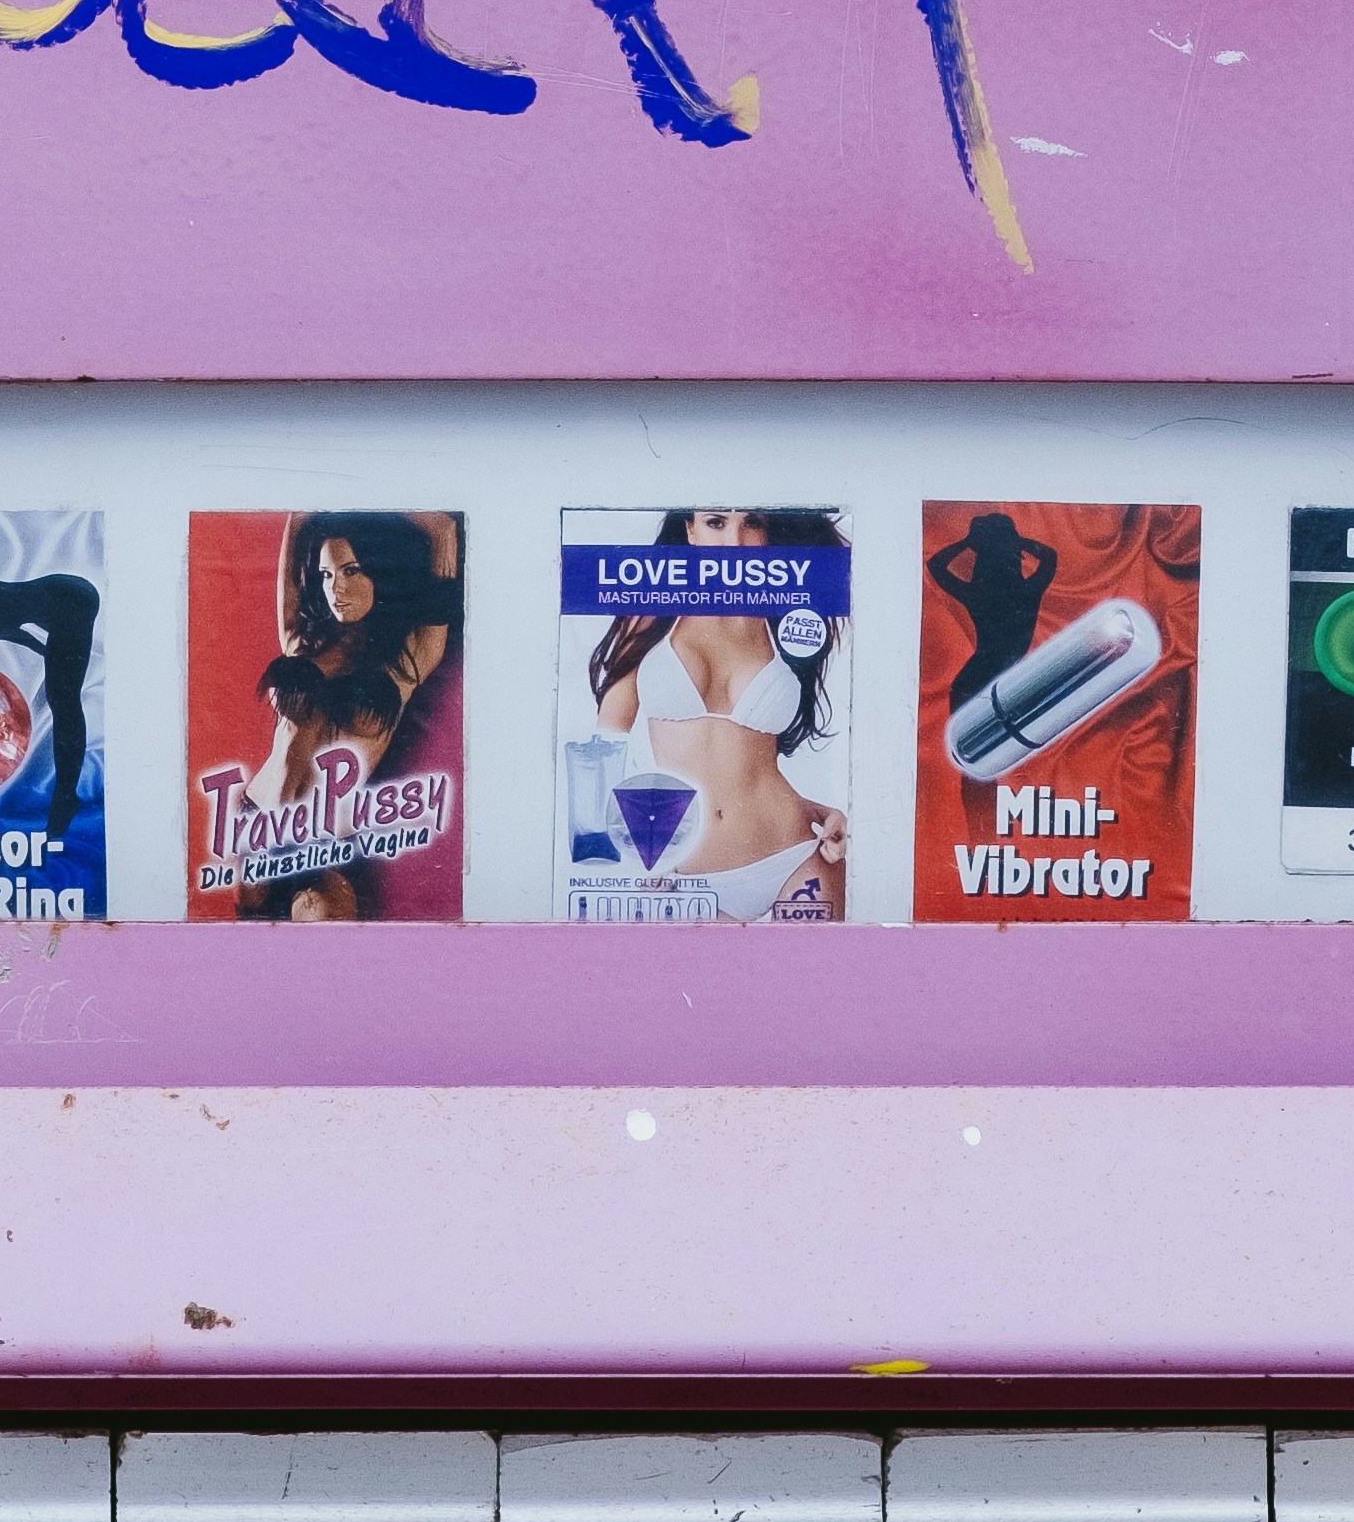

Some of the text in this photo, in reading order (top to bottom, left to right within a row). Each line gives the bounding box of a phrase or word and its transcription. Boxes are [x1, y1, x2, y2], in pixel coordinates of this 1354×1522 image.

[598, 558, 811, 586] LOVE PUSSY
[598, 589, 811, 605] MASTURBATOR FÜR MÄNNER
[786, 615, 823, 629] PASST
[782, 625, 822, 640] ALLEN
[995, 785, 1115, 837] Mini-
[200, 826, 430, 891] Die künstliche Vagina
[954, 844, 1151, 898] Vibrator
[569, 877, 632, 888] INKLUSIVE
[780, 908, 825, 921] LOVE
